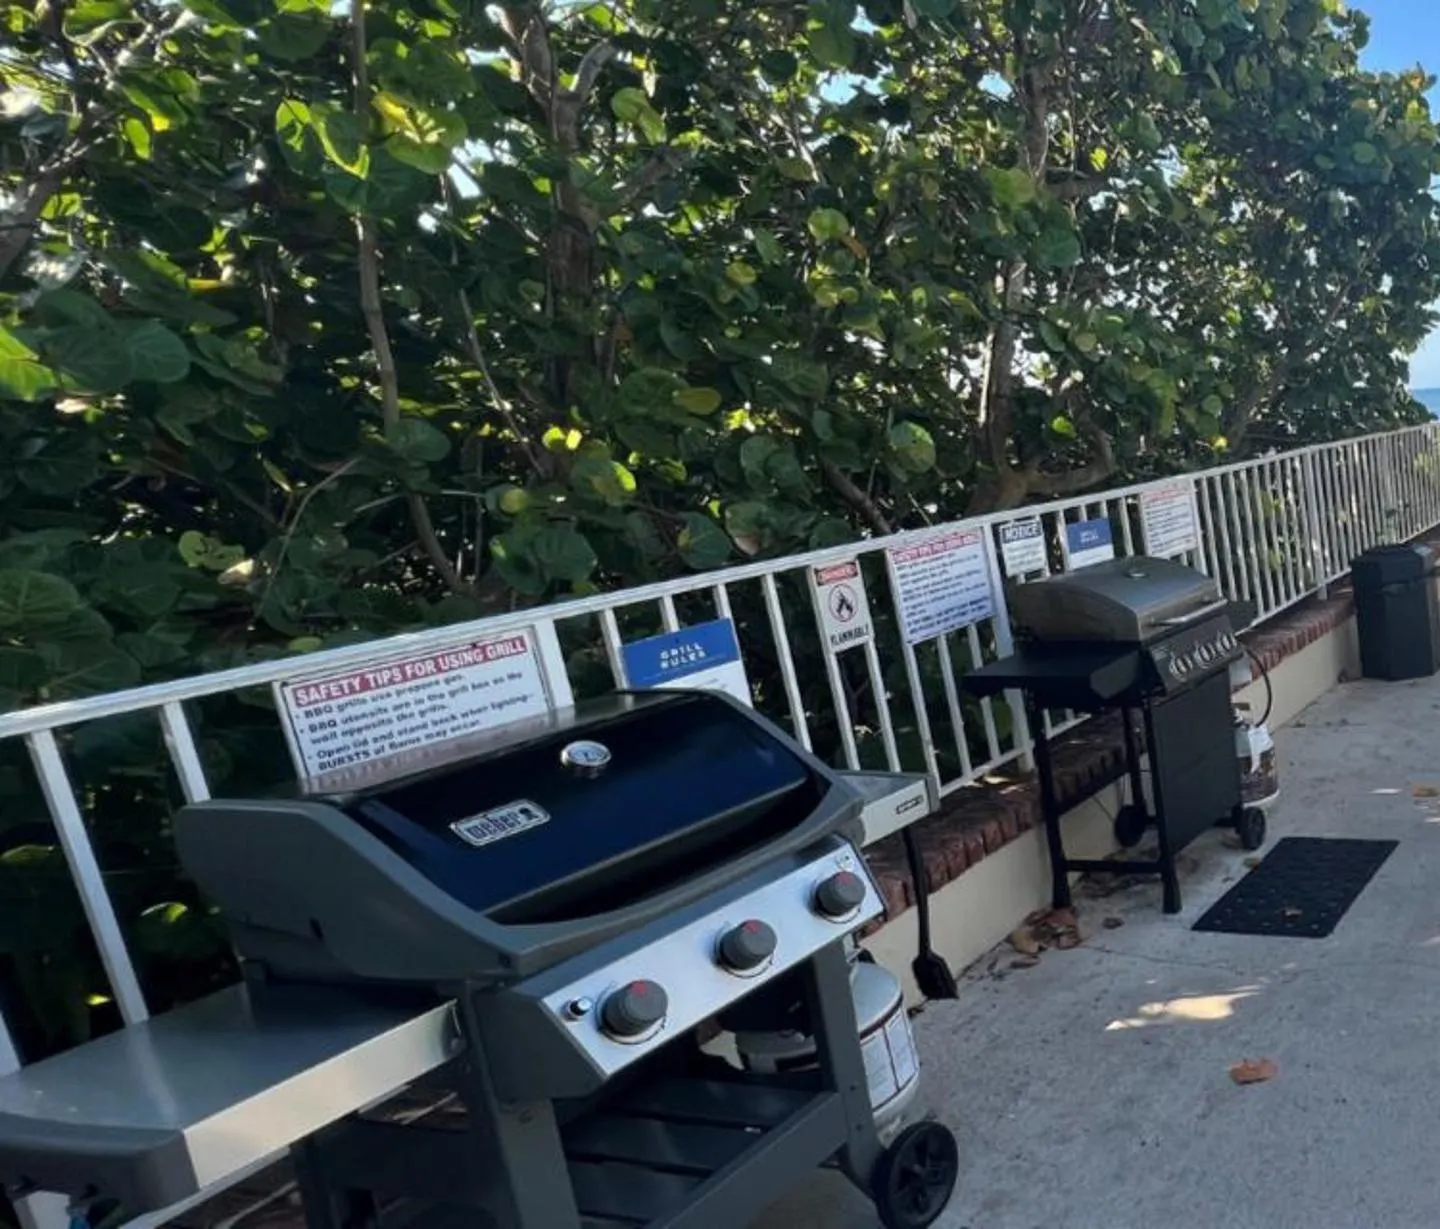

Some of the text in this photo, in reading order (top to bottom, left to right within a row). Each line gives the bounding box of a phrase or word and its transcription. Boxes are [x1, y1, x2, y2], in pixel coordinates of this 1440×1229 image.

[660, 642, 703, 660] GRILL
[660, 650, 706, 669] RULES
[295, 637, 524, 704] SAFETY TIPS FOR USING GRILL
[303, 704, 333, 718] BBQ
[307, 718, 337, 733] BBQ
